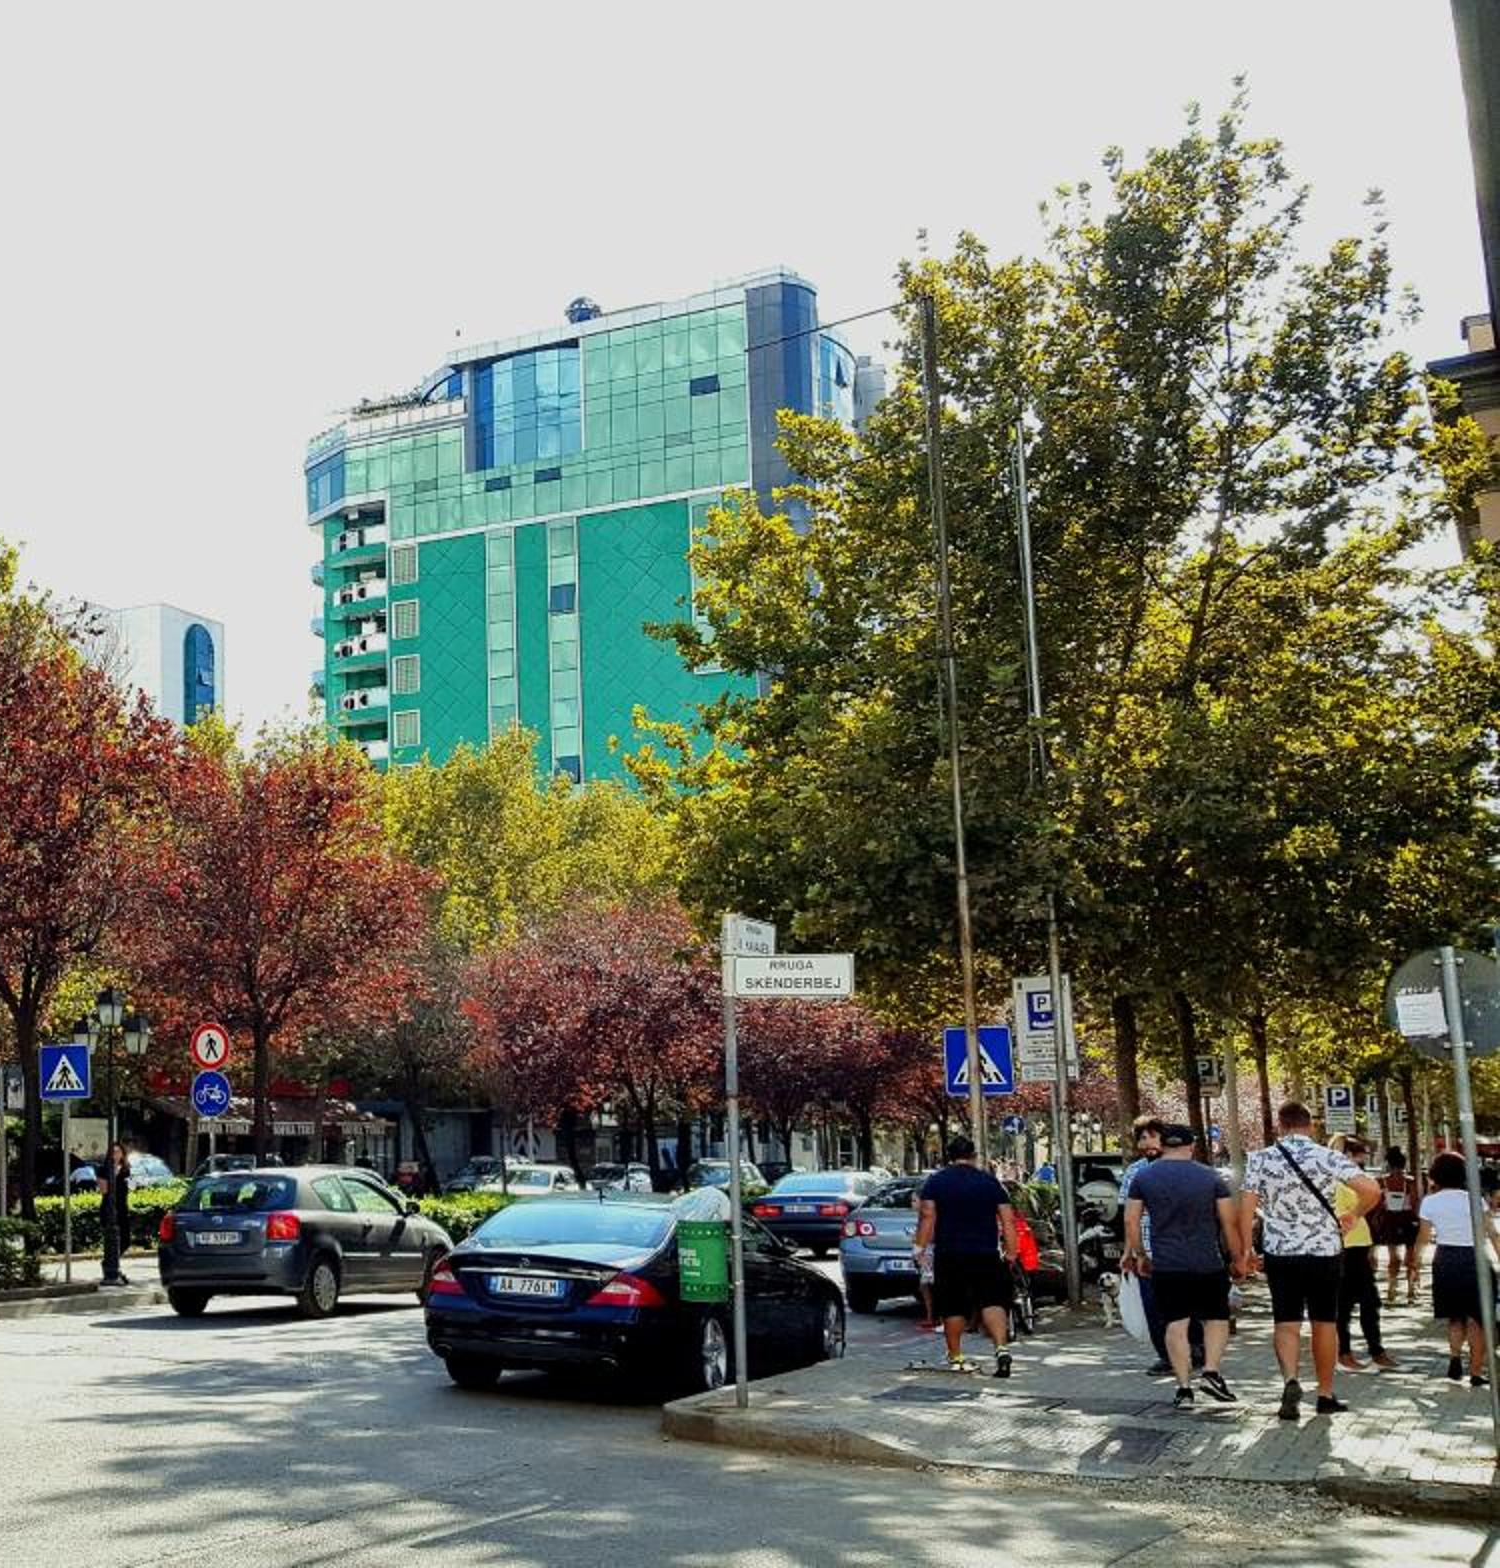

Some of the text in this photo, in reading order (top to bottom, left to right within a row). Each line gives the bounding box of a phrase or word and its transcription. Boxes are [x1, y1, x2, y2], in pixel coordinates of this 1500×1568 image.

[769, 959, 814, 971] RRUGA
[1037, 996, 1047, 1009] P
[1330, 1089, 1347, 1106] P
